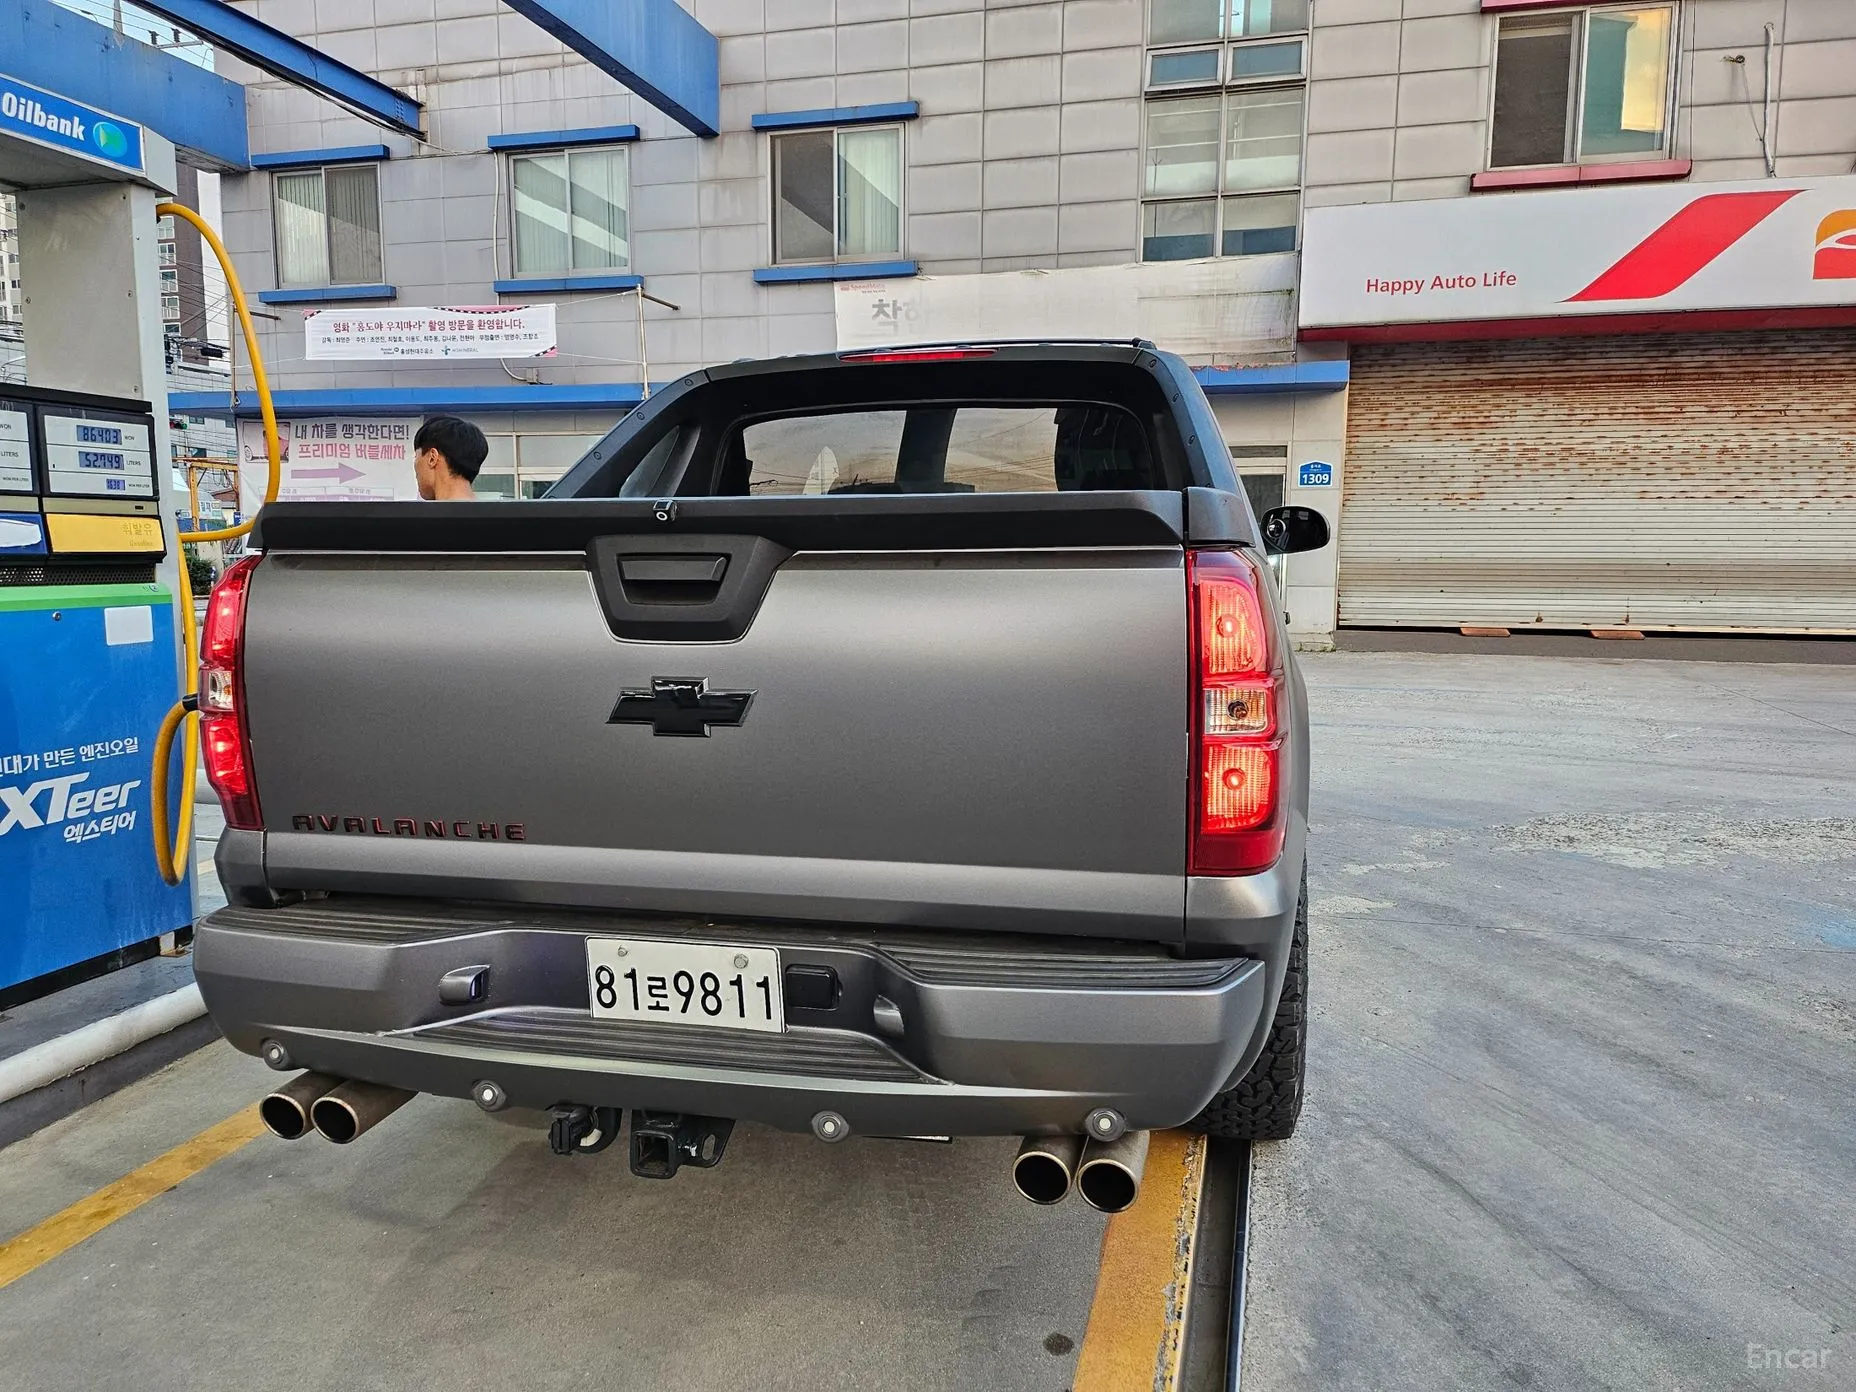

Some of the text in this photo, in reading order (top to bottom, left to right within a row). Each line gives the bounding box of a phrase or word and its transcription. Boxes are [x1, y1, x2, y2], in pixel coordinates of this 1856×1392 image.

[2, 91, 86, 141] Oilbank
[1366, 270, 1517, 296] Happy Auto Life
[333, 322, 350, 333] 영화
[428, 320, 446, 332] 촬영
[448, 319, 475, 331] 방문을
[477, 318, 525, 330] 환영합니다.
[83, 427, 118, 444] 86403
[295, 423, 409, 441] 내 차를 생각한다면!
[298, 443, 406, 461] 프리미엄 버블세차
[1302, 473, 1329, 484] 1309
[121, 523, 153, 536] 휘발유
[43, 747, 76, 769] 만든
[79, 736, 139, 762] 엔진오일
[63, 810, 137, 843] 엑스티어
[291, 814, 526, 841] AVALANCHE
[594, 964, 772, 1020] 81로9811
